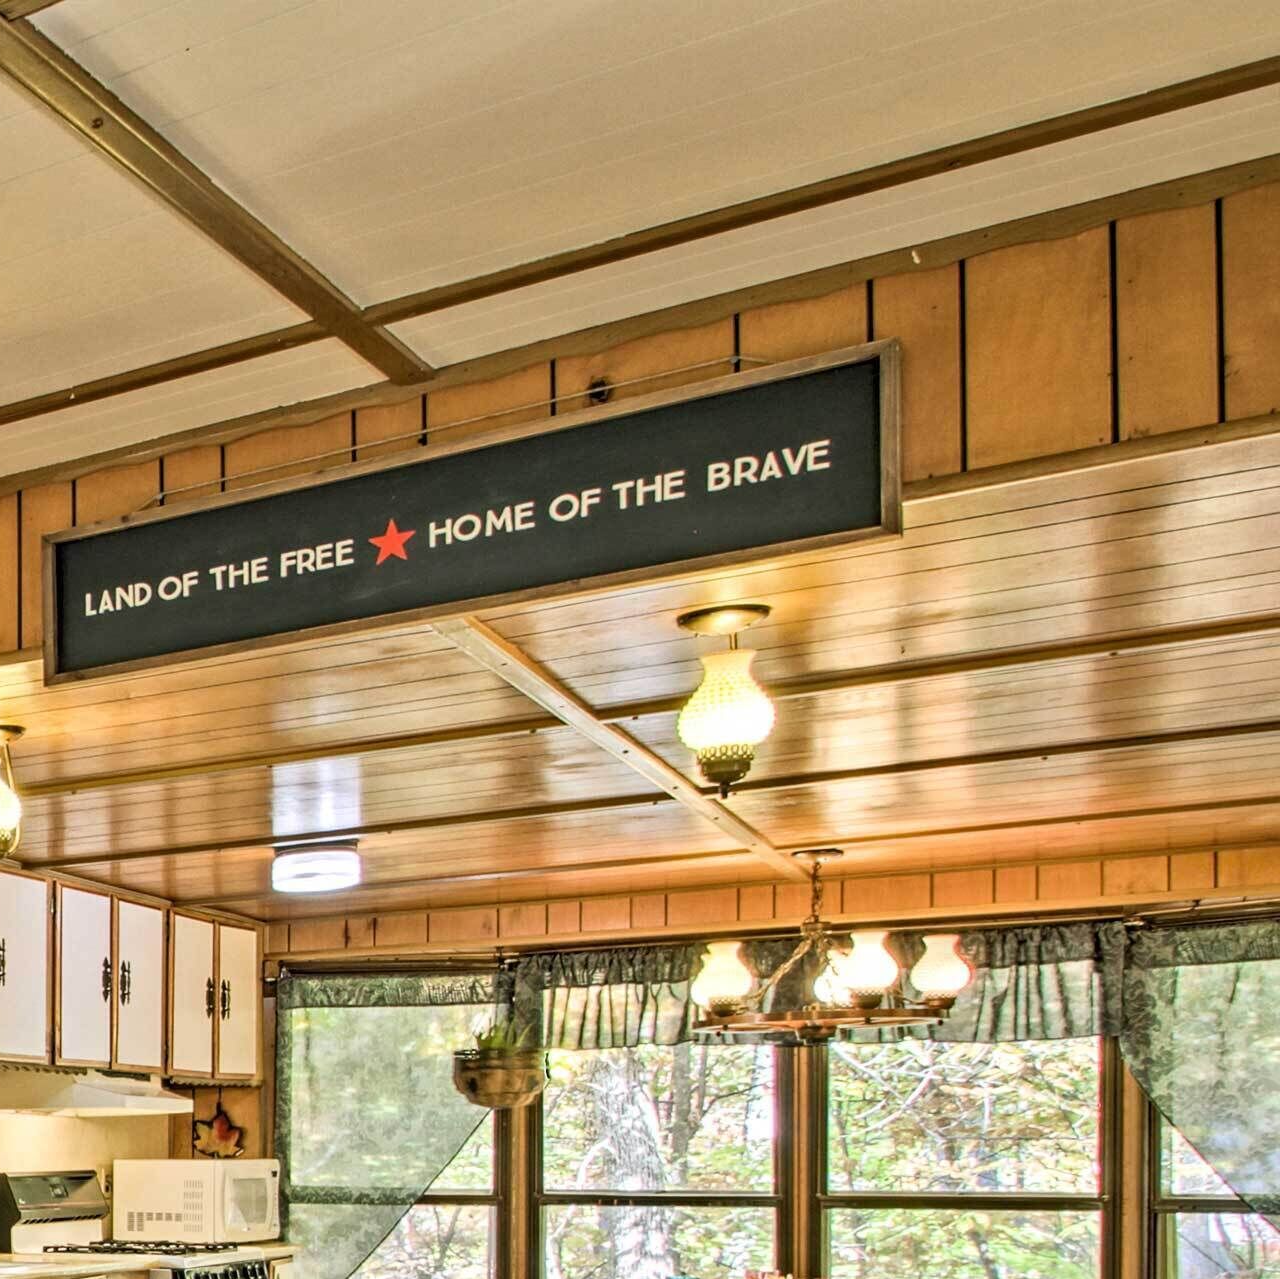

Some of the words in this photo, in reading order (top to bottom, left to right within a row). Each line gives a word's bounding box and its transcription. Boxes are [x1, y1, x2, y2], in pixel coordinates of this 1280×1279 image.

[85, 582, 153, 617] LAND
[157, 570, 200, 601] OF
[209, 556, 270, 591] THE
[280, 539, 355, 578] FREE
[429, 501, 536, 548] HOME
[548, 487, 603, 522] OF
[611, 470, 687, 510] THE
[707, 439, 831, 492] BRAVE
